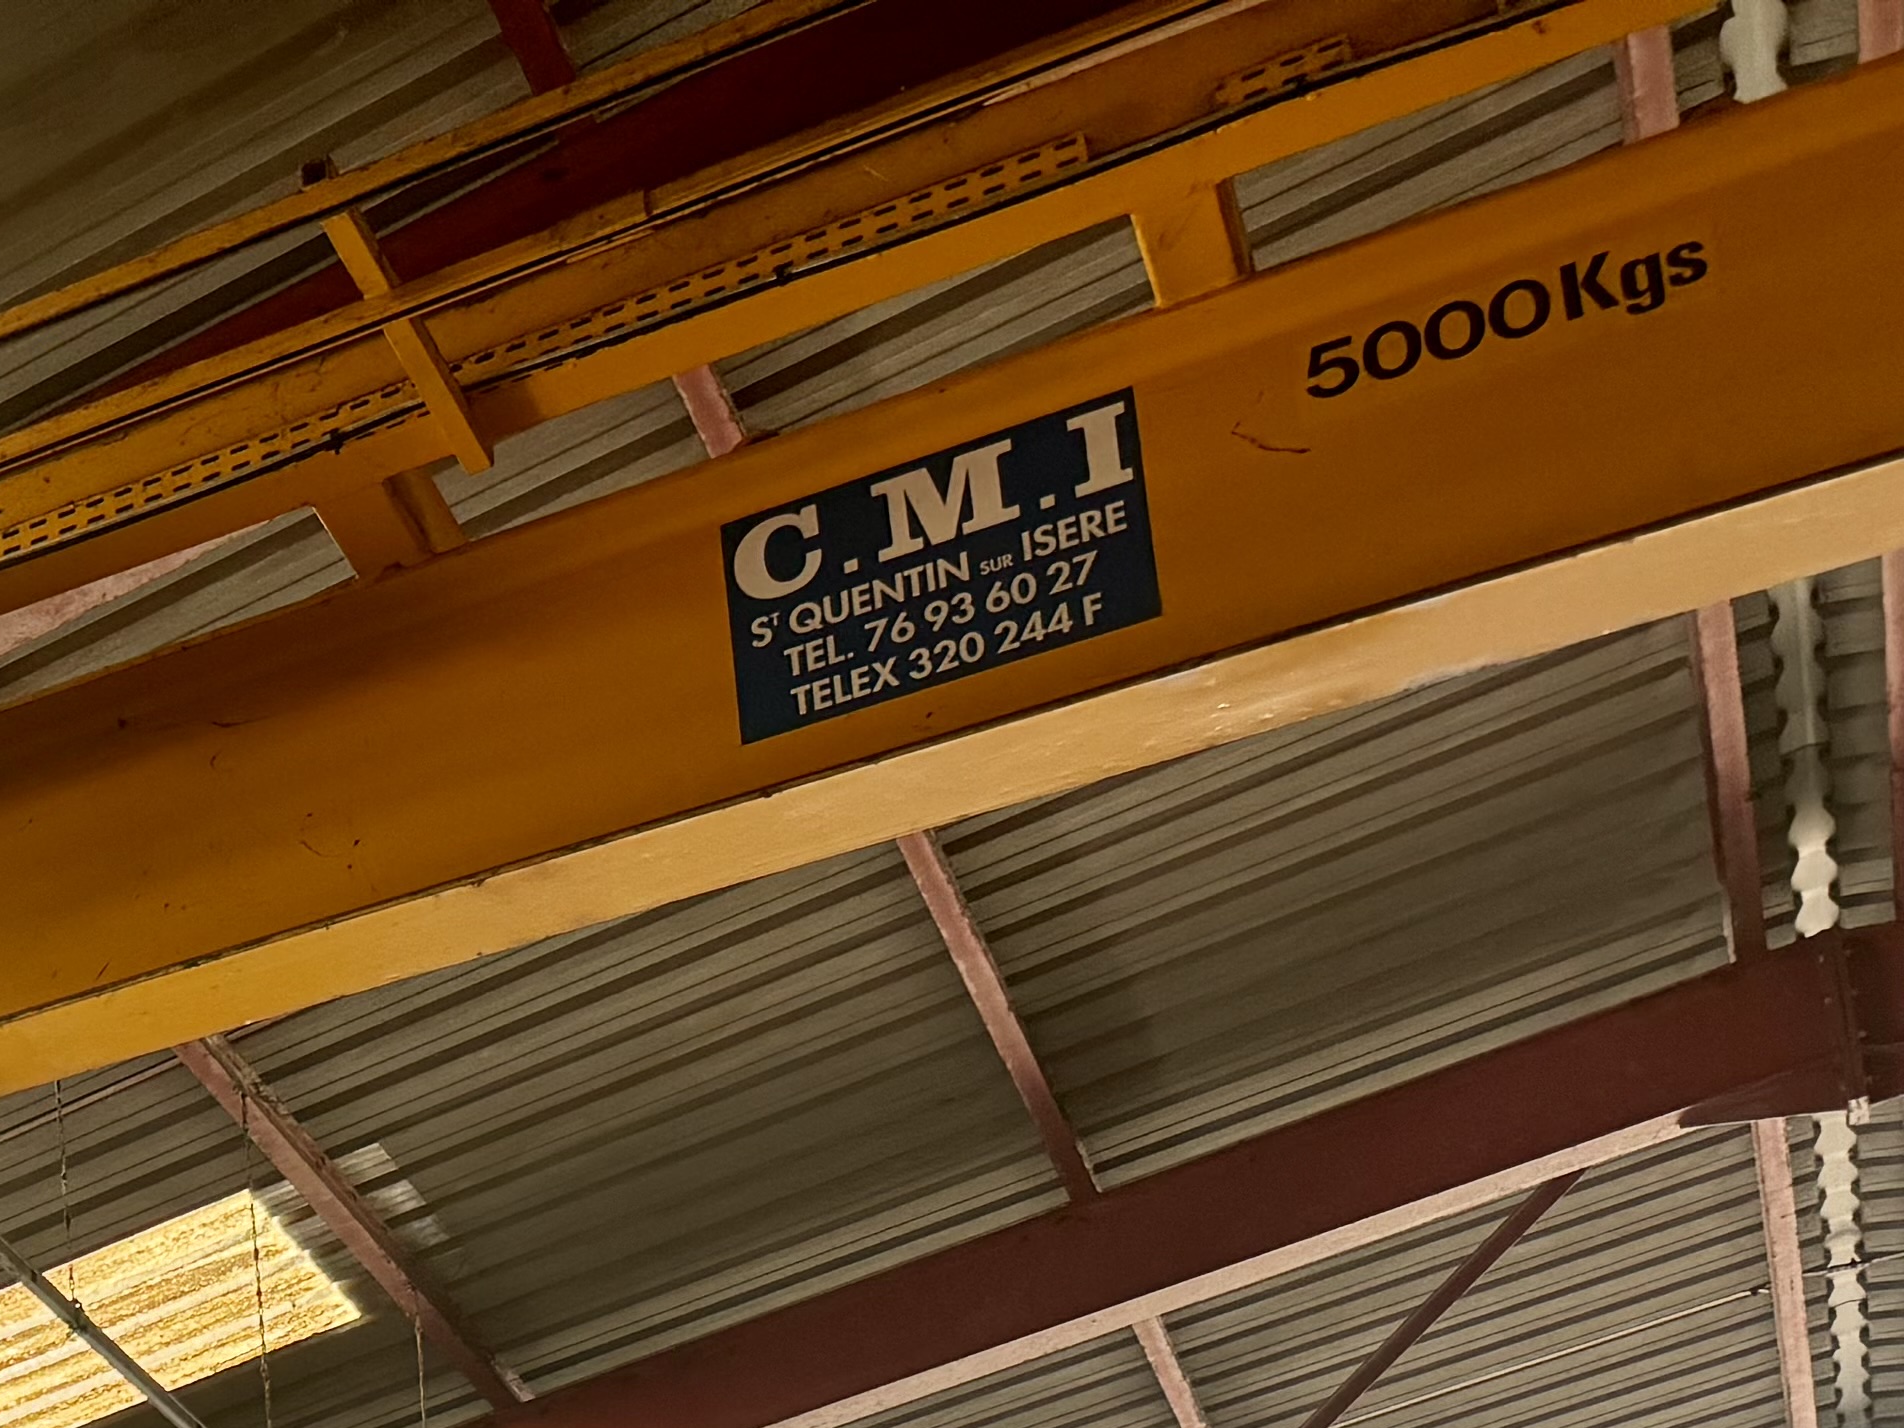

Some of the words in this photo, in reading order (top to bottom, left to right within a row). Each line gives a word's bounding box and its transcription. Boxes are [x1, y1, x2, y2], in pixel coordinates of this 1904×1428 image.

[784, 636, 853, 677] TEL.
[865, 612, 915, 651] 76
[924, 592, 975, 632] 93
[985, 571, 1037, 612] 60
[1046, 550, 1098, 594] 27
[789, 552, 970, 635] QUENTIN
[980, 553, 1013, 575] SUR
[1022, 500, 1128, 560] ISERE
[790, 657, 898, 716] TELEX
[908, 631, 984, 680] 320
[995, 610, 1073, 653] 244
[1083, 592, 1103, 626] F
